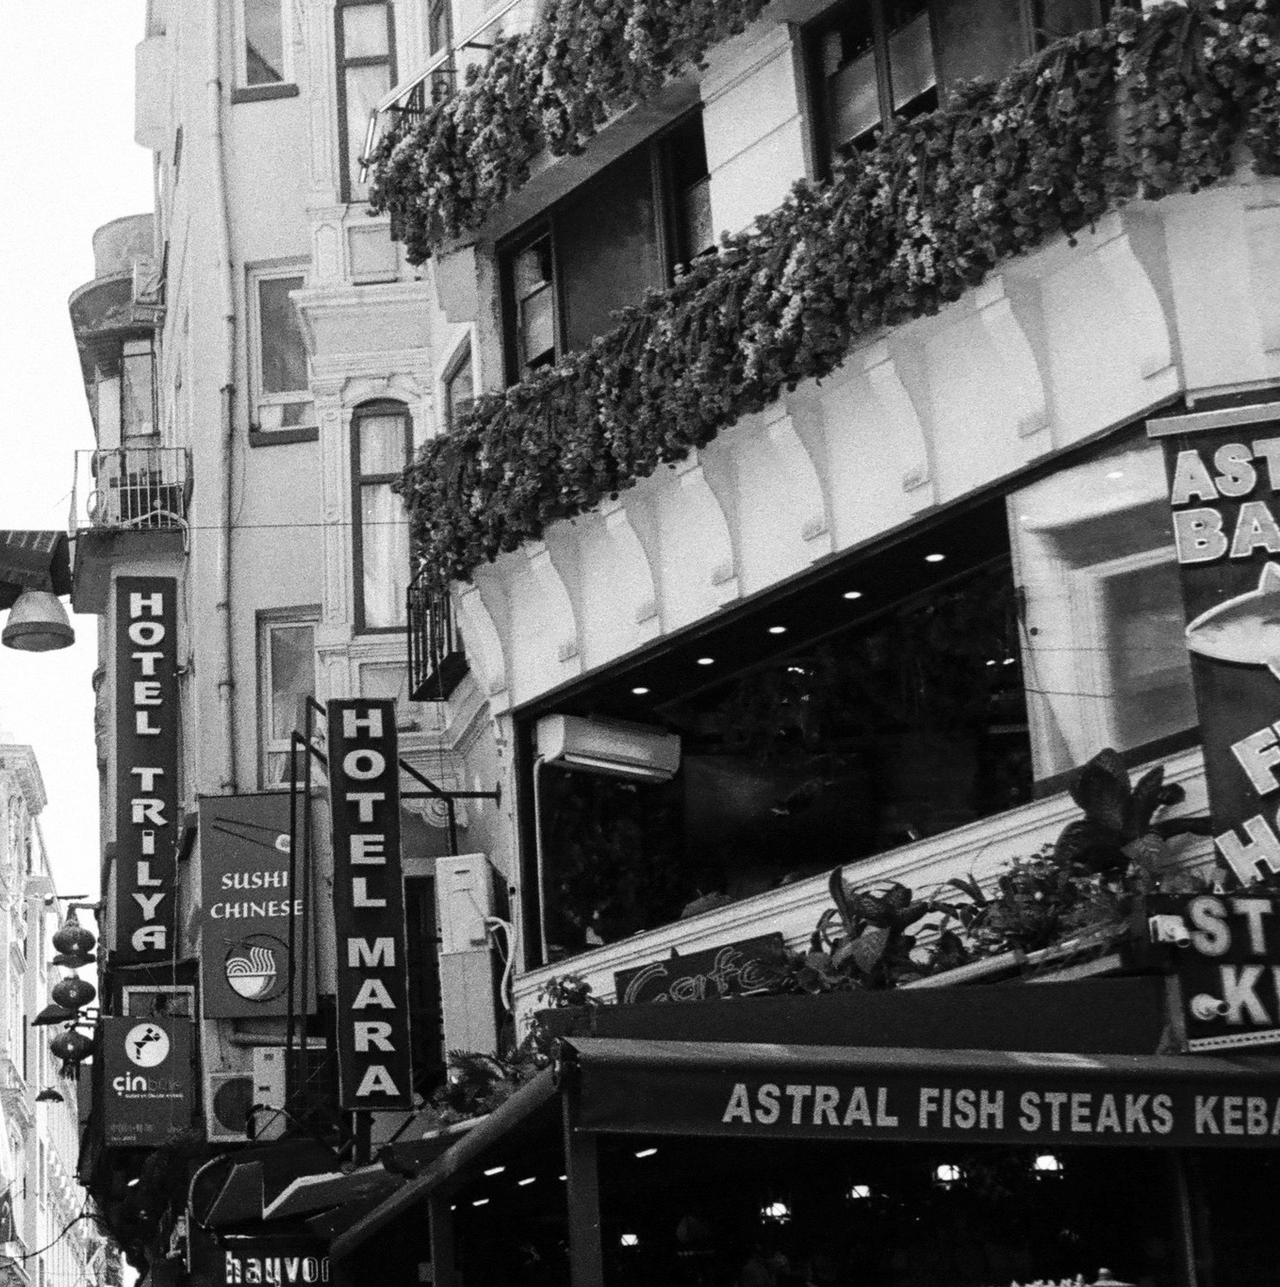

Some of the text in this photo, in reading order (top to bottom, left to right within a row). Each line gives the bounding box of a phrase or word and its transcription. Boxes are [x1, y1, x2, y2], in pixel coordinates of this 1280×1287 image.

[1171, 436, 1280, 505] AST
[1173, 501, 1280, 564] BA
[129, 592, 164, 736] HOTEL
[1231, 718, 1280, 796] F
[211, 899, 303, 920] CHINESE
[221, 870, 289, 891] SUSHI
[342, 708, 401, 1097] HOTEL MARA
[722, 1083, 898, 1127] ASTRAL
[919, 1087, 1004, 1129] FISH
[1020, 1091, 1174, 1135] STEAKS
